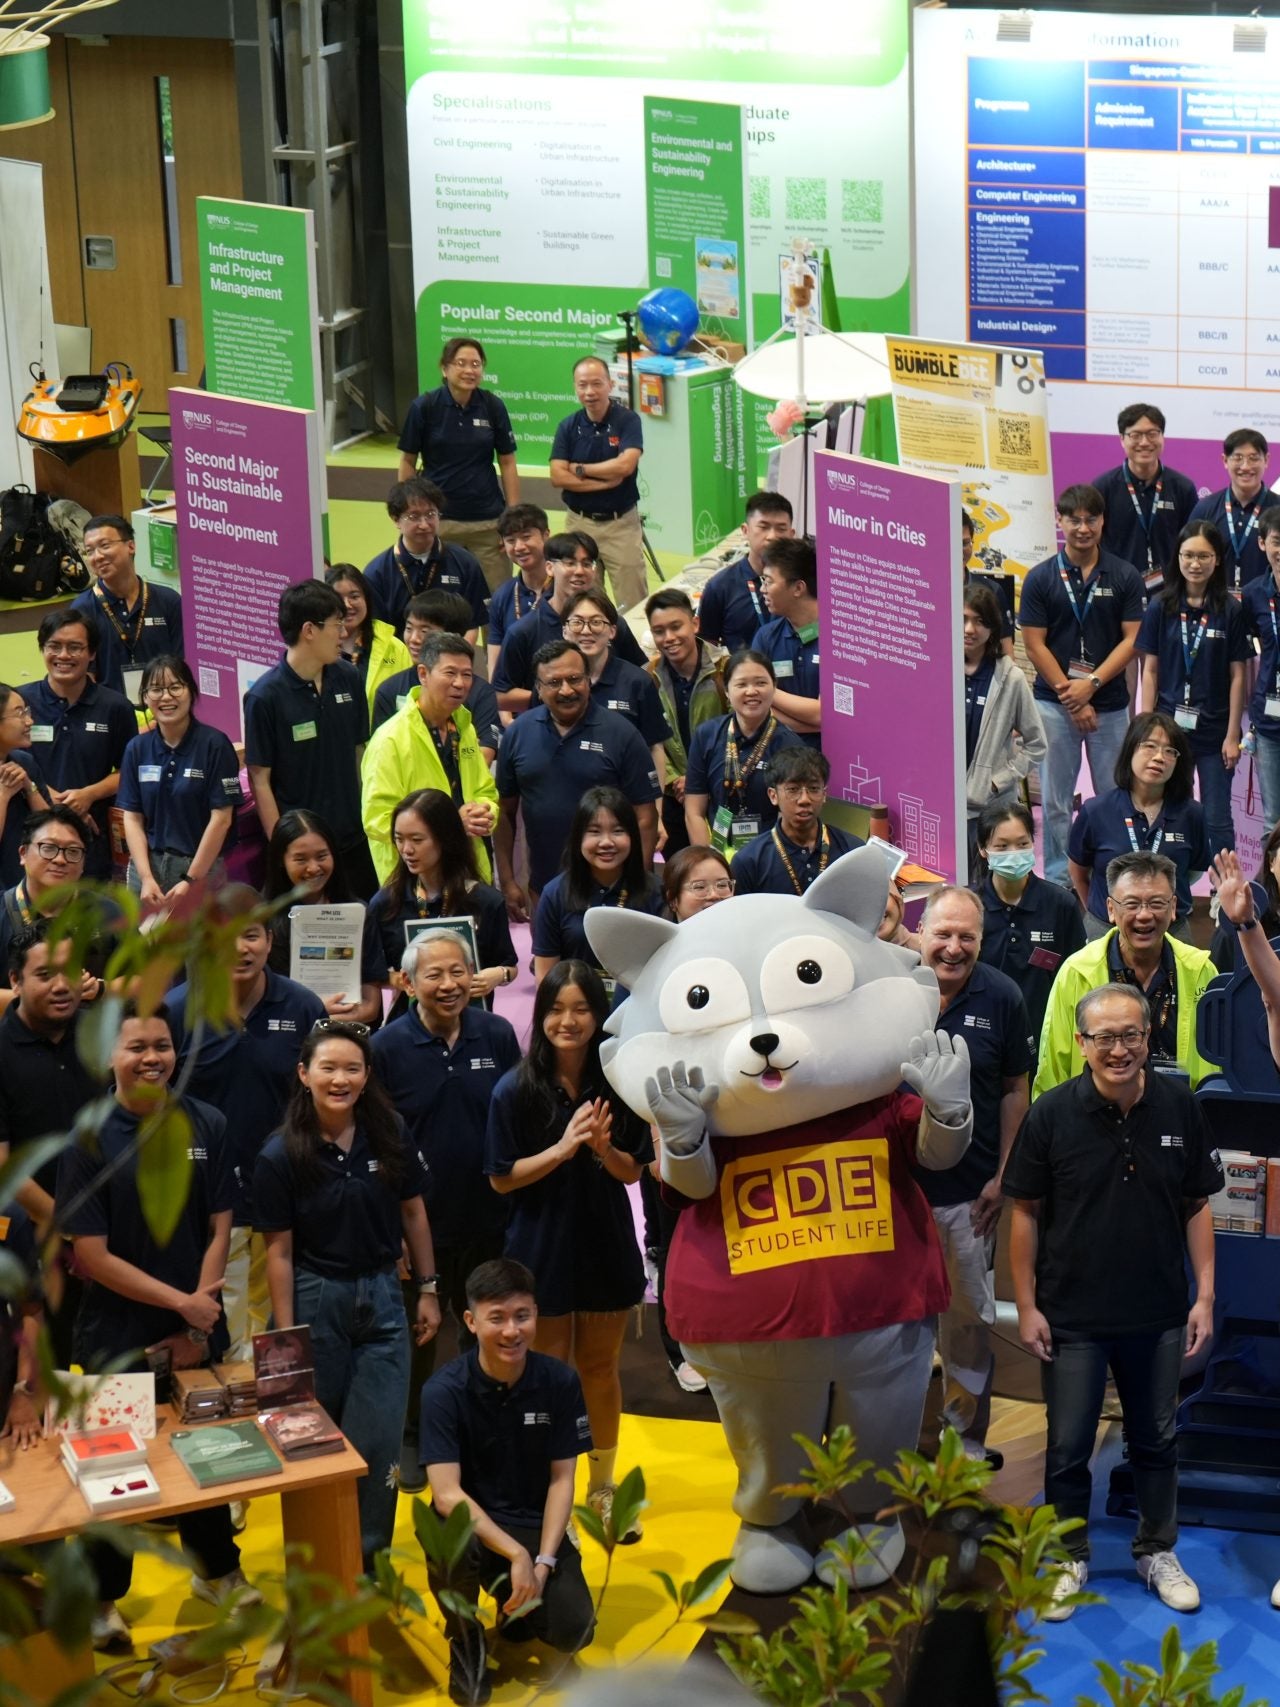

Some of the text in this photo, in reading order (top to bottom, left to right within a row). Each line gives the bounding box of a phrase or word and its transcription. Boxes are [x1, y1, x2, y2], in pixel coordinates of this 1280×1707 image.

[433, 93, 552, 111] Specialisations
[1095, 103, 1145, 114] Admission
[1095, 114, 1154, 128] Requirement
[434, 138, 512, 151] Civil Engineering
[652, 132, 733, 152] Environmental and
[652, 148, 711, 166] Sustainability
[435, 173, 503, 184] Environmental
[652, 162, 704, 180] Engineering
[435, 187, 509, 200] & Sustainability
[976, 189, 1076, 205] Computer Engineering
[436, 201, 491, 212] Engineering
[976, 212, 1029, 224] Engineering
[437, 227, 501, 237] Infrastructure
[543, 230, 614, 240] Sustainable Green
[209, 242, 284, 266] Infrastructure
[438, 240, 480, 250] & Project
[543, 242, 580, 250] Buildings
[438, 252, 499, 264] Management
[1199, 262, 1229, 271] BBB/C
[210, 262, 272, 282] and Project
[211, 277, 282, 301] Management
[441, 303, 500, 322] Popular
[505, 306, 562, 323] Second
[567, 309, 612, 328] Major
[977, 320, 1020, 330] Industrial
[1199, 331, 1228, 340] BBC/B
[1198, 366, 1228, 375] CCC/B
[194, 412, 212, 424] NUS
[712, 386, 723, 463] Engineering
[724, 384, 735, 470] Sustainability
[736, 386, 747, 497] nvironmental and
[185, 447, 279, 481] Second Major
[187, 468, 282, 502] in Sustainable
[838, 472, 855, 486] NUS
[188, 491, 228, 513] Urban
[189, 512, 278, 546] Development
[828, 506, 926, 546] Minor in Cities
[192, 555, 207, 564] Cities
[217, 560, 236, 570] shaped
[237, 565, 243, 573] by
[830, 546, 920, 576] The Minor in Cities equips students
[842, 560, 850, 568] the
[851, 562, 865, 571] skills
[872, 570, 901, 581] understand
[902, 575, 914, 584] how
[915, 579, 930, 589] cities
[735, 1159, 875, 1224] CDE
[731, 1219, 889, 1260] STUDENT LIFE
